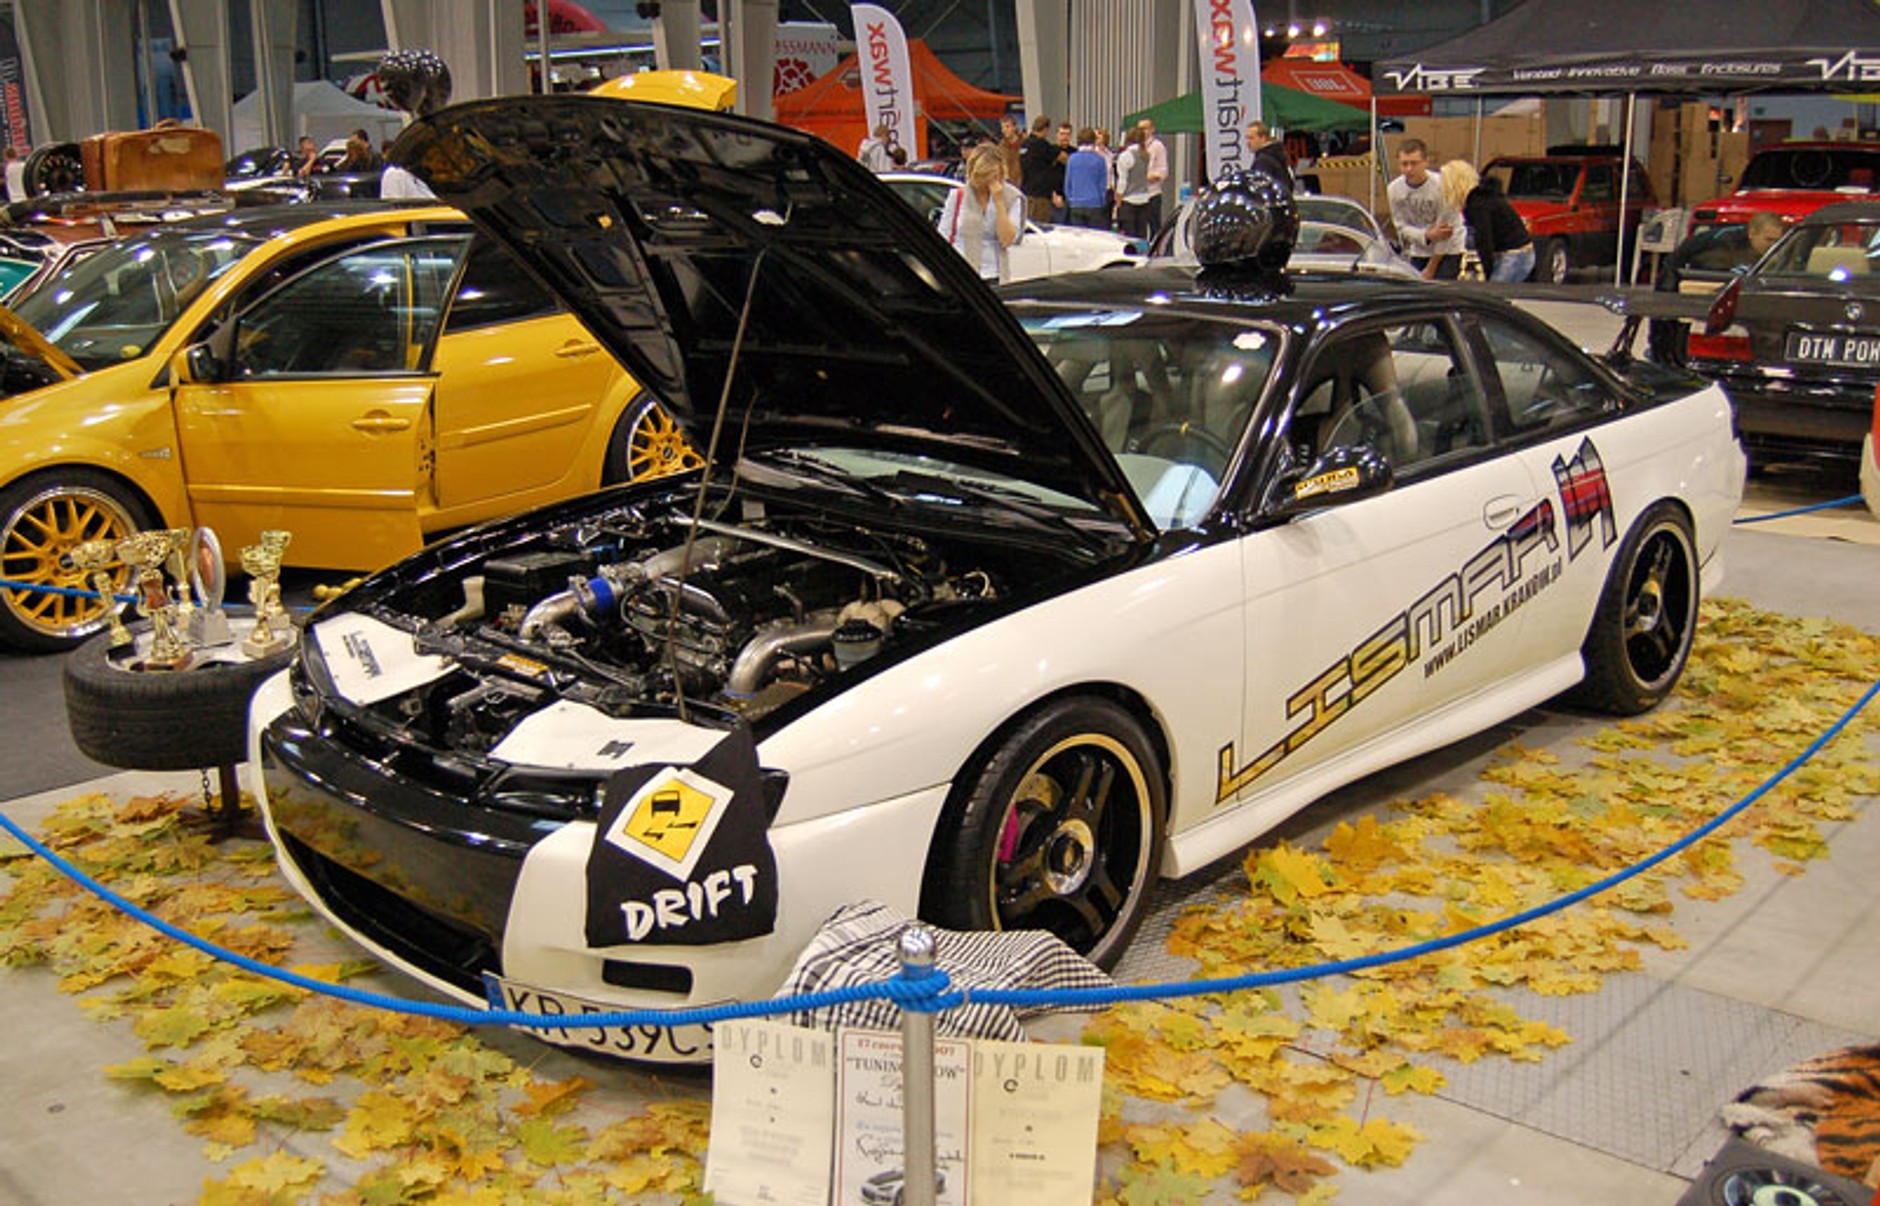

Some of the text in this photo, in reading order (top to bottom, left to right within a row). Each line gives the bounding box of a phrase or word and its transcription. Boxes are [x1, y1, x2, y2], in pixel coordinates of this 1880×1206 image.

[1384, 63, 1487, 91] VIBE
[1700, 62, 1783, 76] Enclosures
[1798, 337, 1836, 359] DTM
[1215, 497, 1560, 805] LISMAR
[620, 864, 758, 942] DRIFT
[721, 1024, 827, 1069] DYPLOM
[973, 1051, 1095, 1083] DYPLOM
